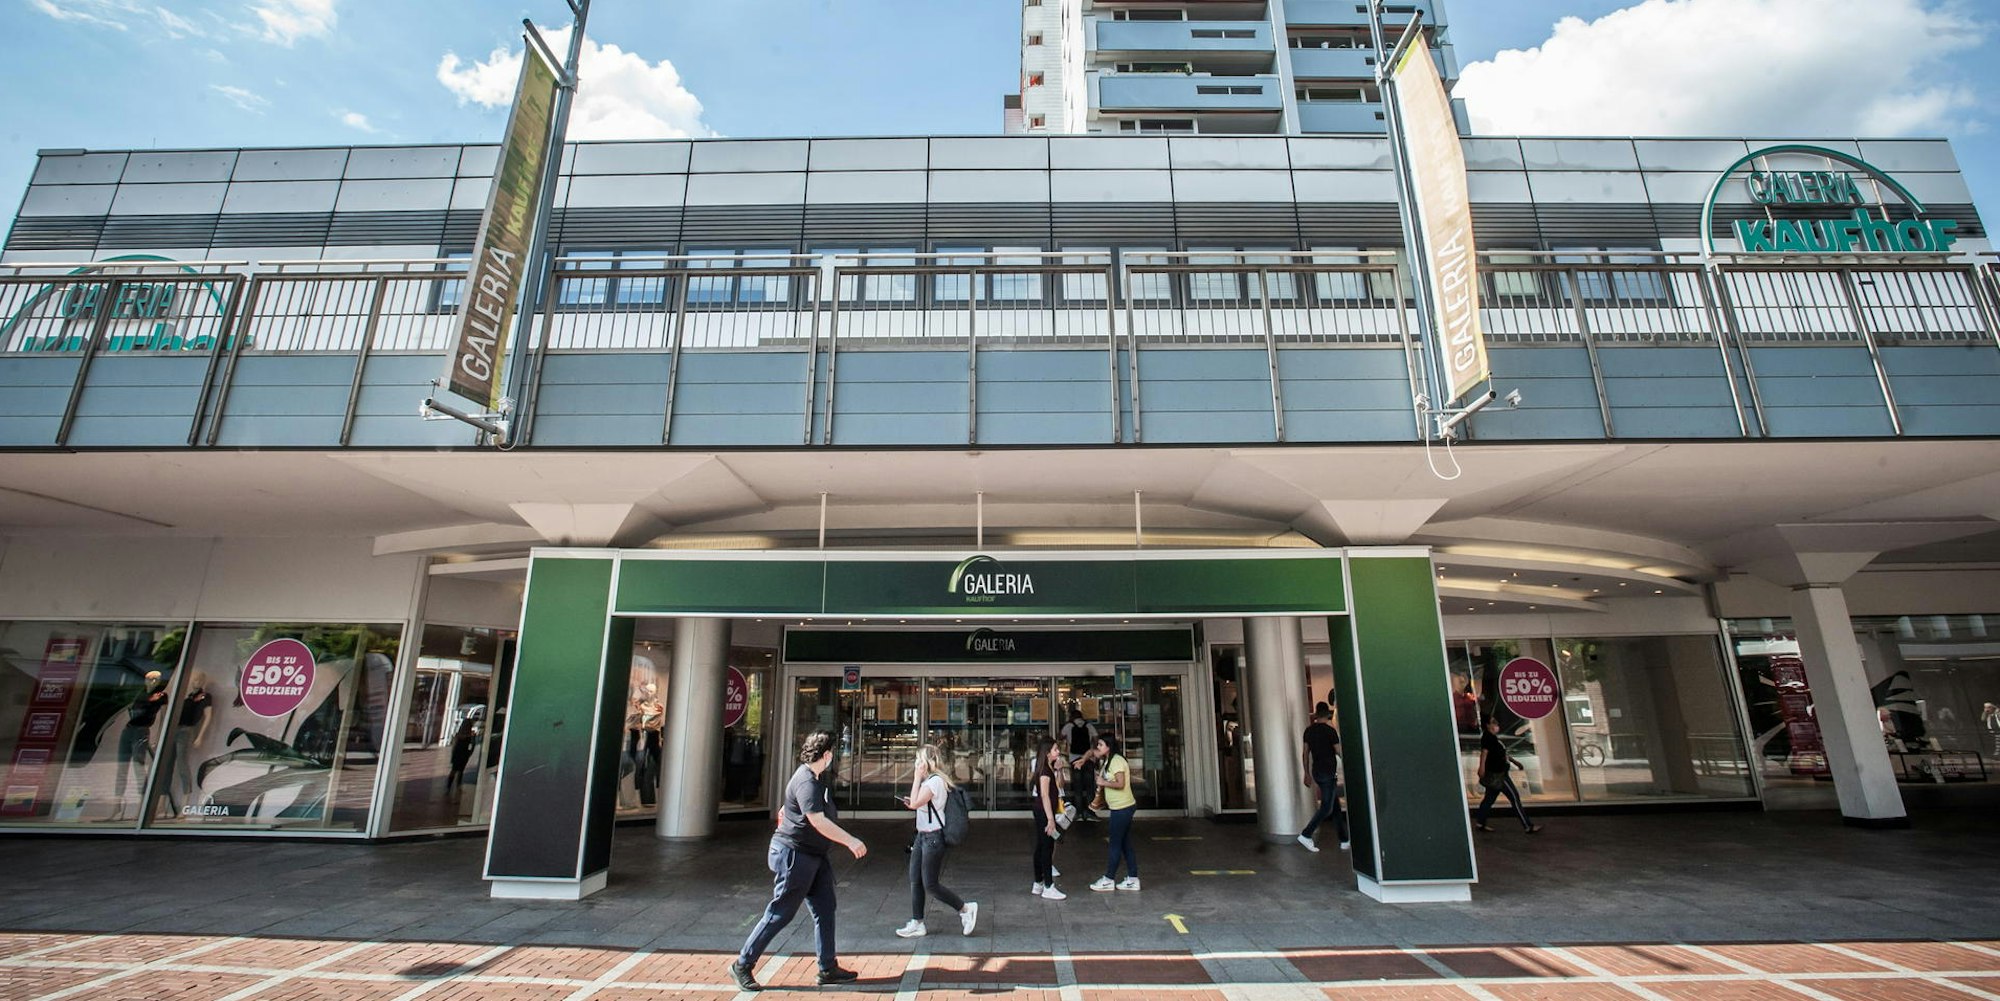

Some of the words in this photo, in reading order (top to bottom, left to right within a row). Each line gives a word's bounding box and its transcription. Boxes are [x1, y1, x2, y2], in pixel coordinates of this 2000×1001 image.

[1747, 171, 1865, 204] GALERIA
[62, 284, 178, 318] GAERIA
[1437, 228, 1476, 373] GALERIA
[462, 246, 515, 383] GALERIA
[964, 573, 1034, 594] GALERIA
[974, 638, 1016, 651] GALERIA
[266, 656, 281, 664] BIS
[283, 656, 297, 664] ZU
[247, 665, 307, 686] 50%
[245, 686, 304, 696] REDUZIERT
[1505, 678, 1553, 695] 50%
[1506, 694, 1553, 703] REDUZIERT
[182, 805, 230, 816] GALERIA
